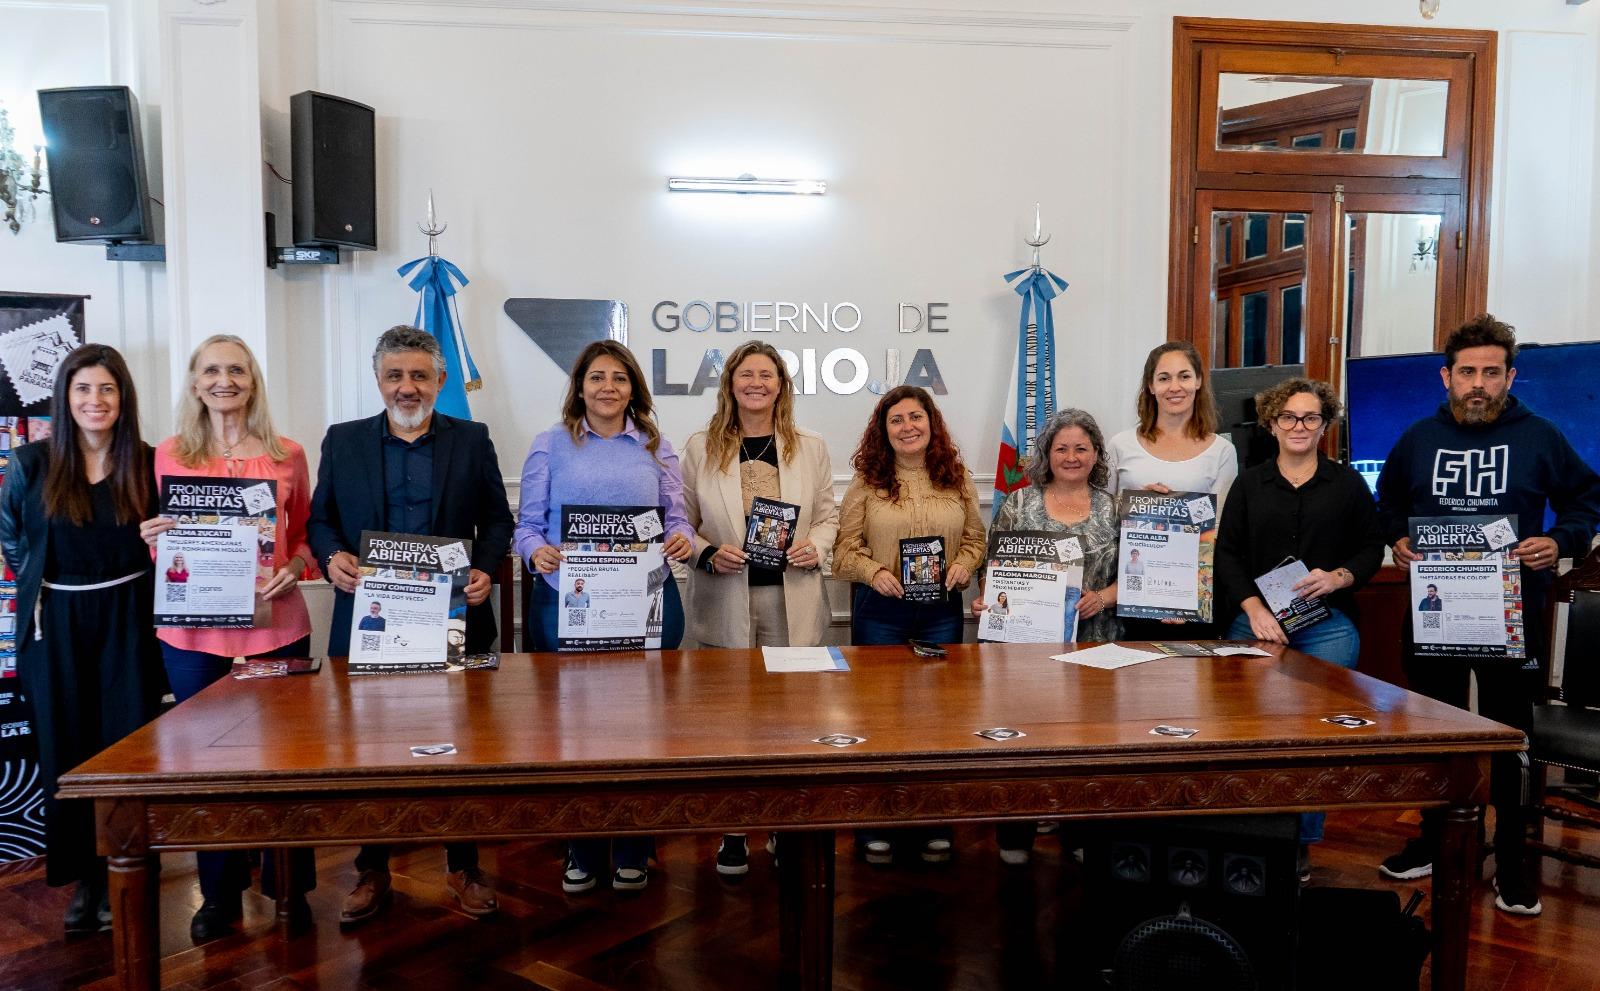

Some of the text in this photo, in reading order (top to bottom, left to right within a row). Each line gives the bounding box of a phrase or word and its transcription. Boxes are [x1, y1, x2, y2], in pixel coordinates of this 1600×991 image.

[652, 300, 950, 333] GOBIERNO DE
[1026, 324, 1038, 356] UNIDAD
[652, 348, 724, 396] LA
[1026, 363, 1038, 373] LA
[1026, 380, 1036, 398] POR
[1026, 405, 1036, 430] RIOJA
[169, 484, 243, 496] FRONTERAS
[168, 495, 243, 508] ABIERTAS
[1129, 496, 1188, 507] FRONTERAS
[1440, 498, 1498, 506] FEDERICO CHUMBITA
[1129, 504, 1188, 518] ABIERTAS
[568, 513, 634, 524] FRONTERAS
[568, 523, 634, 536] ABIERTAS
[1417, 523, 1484, 535] FRONTERAS
[369, 538, 438, 553] FRONTERAS
[998, 536, 1056, 546] FRONTERAS
[1417, 533, 1484, 546] ABIERTAS
[368, 548, 438, 564] ABIERTAS
[996, 544, 1056, 556] ABIERTAS
[1022, 572, 1056, 580] MARQUEZ
[366, 582, 434, 594] RUDY CONTRERAS
